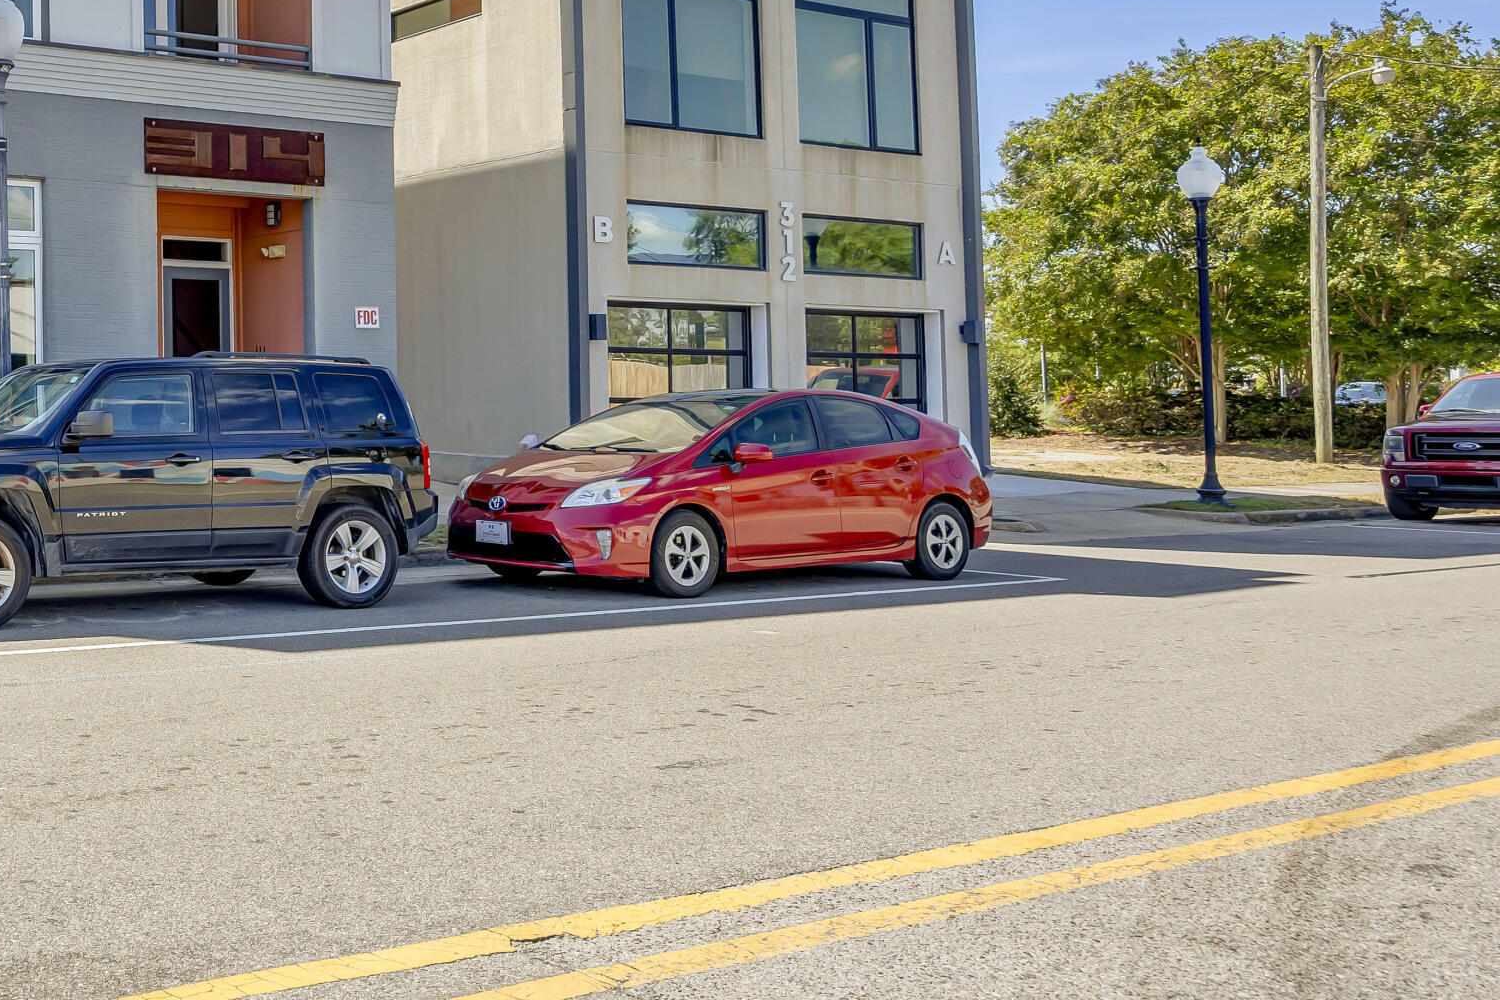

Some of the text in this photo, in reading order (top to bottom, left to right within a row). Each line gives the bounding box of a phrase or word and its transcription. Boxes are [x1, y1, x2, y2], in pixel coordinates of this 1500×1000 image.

[146, 126, 325, 177] 314
[593, 215, 613, 243] B
[780, 201, 797, 282] 312
[937, 240, 956, 265] A
[357, 310, 378, 325] FDC
